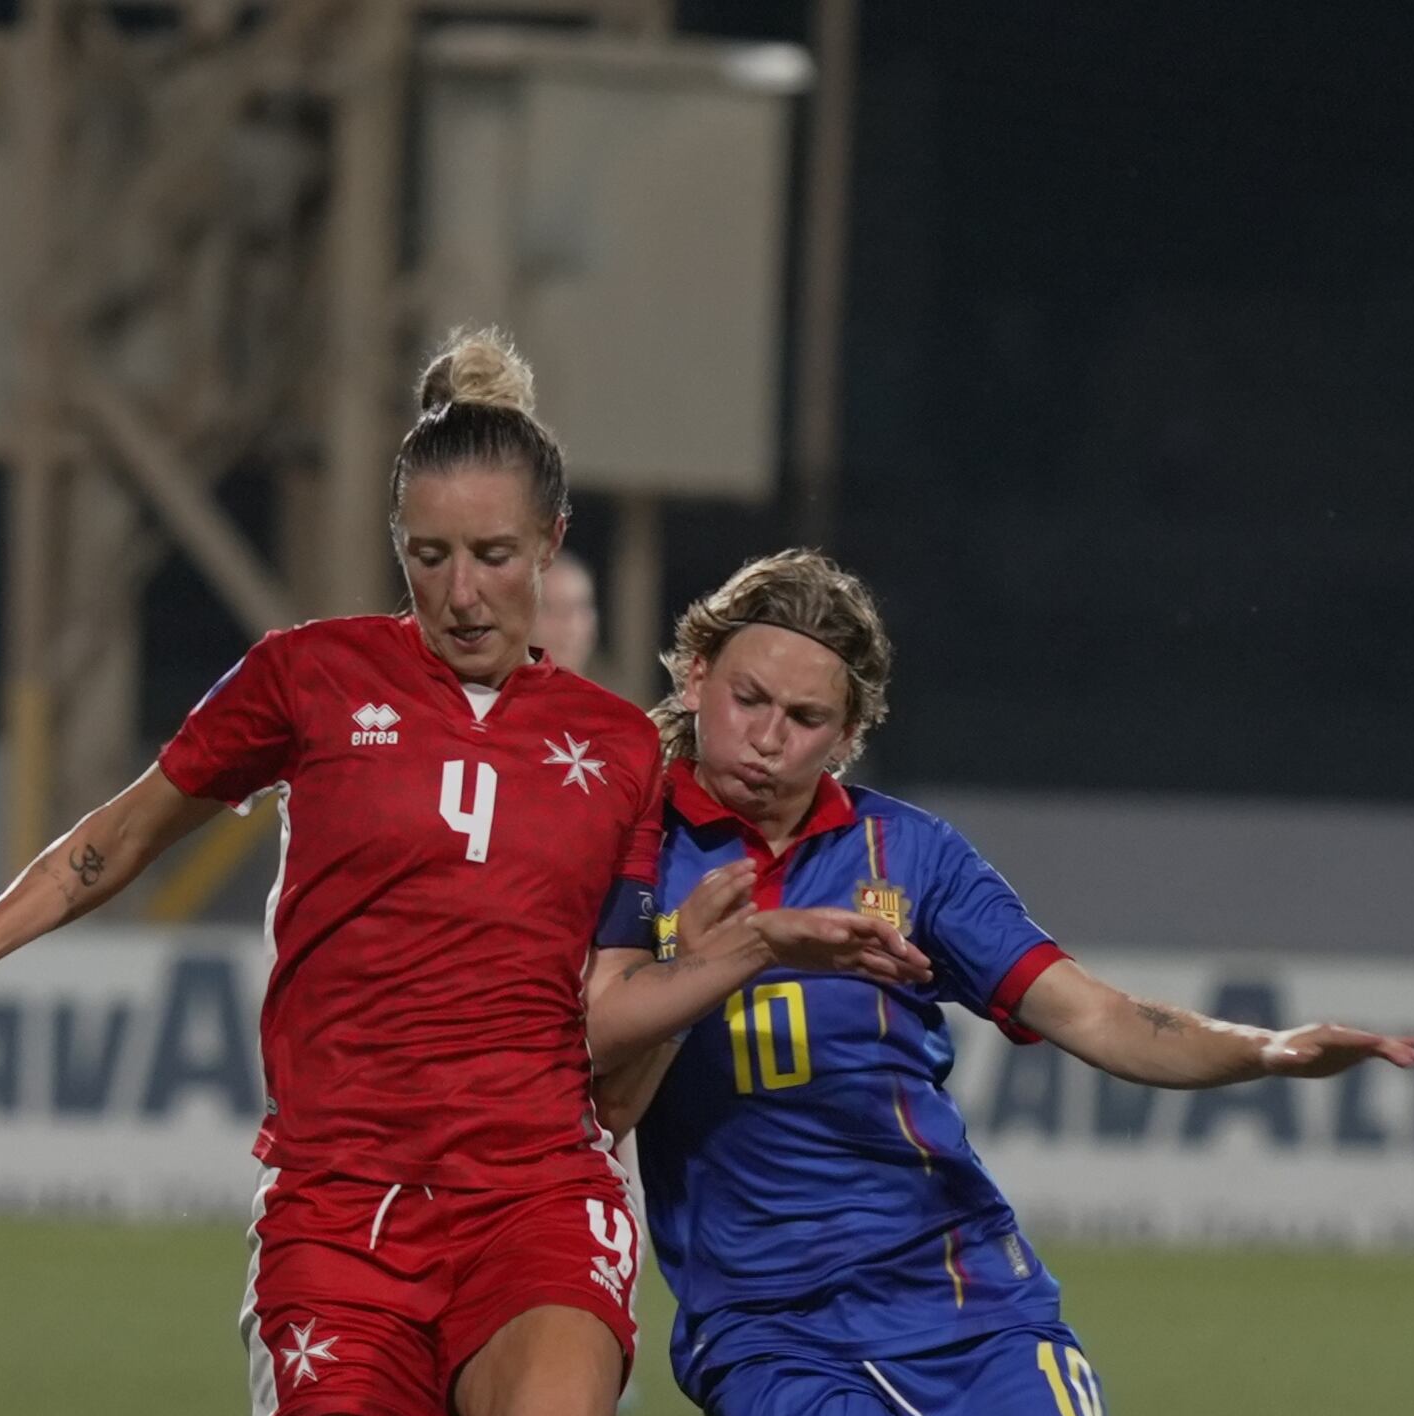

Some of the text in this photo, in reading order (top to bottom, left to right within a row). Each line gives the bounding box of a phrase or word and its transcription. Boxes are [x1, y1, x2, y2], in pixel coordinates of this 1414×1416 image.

[438, 760, 498, 864] 4
[724, 981, 812, 1094] 10
[587, 1199, 635, 1281] 4
